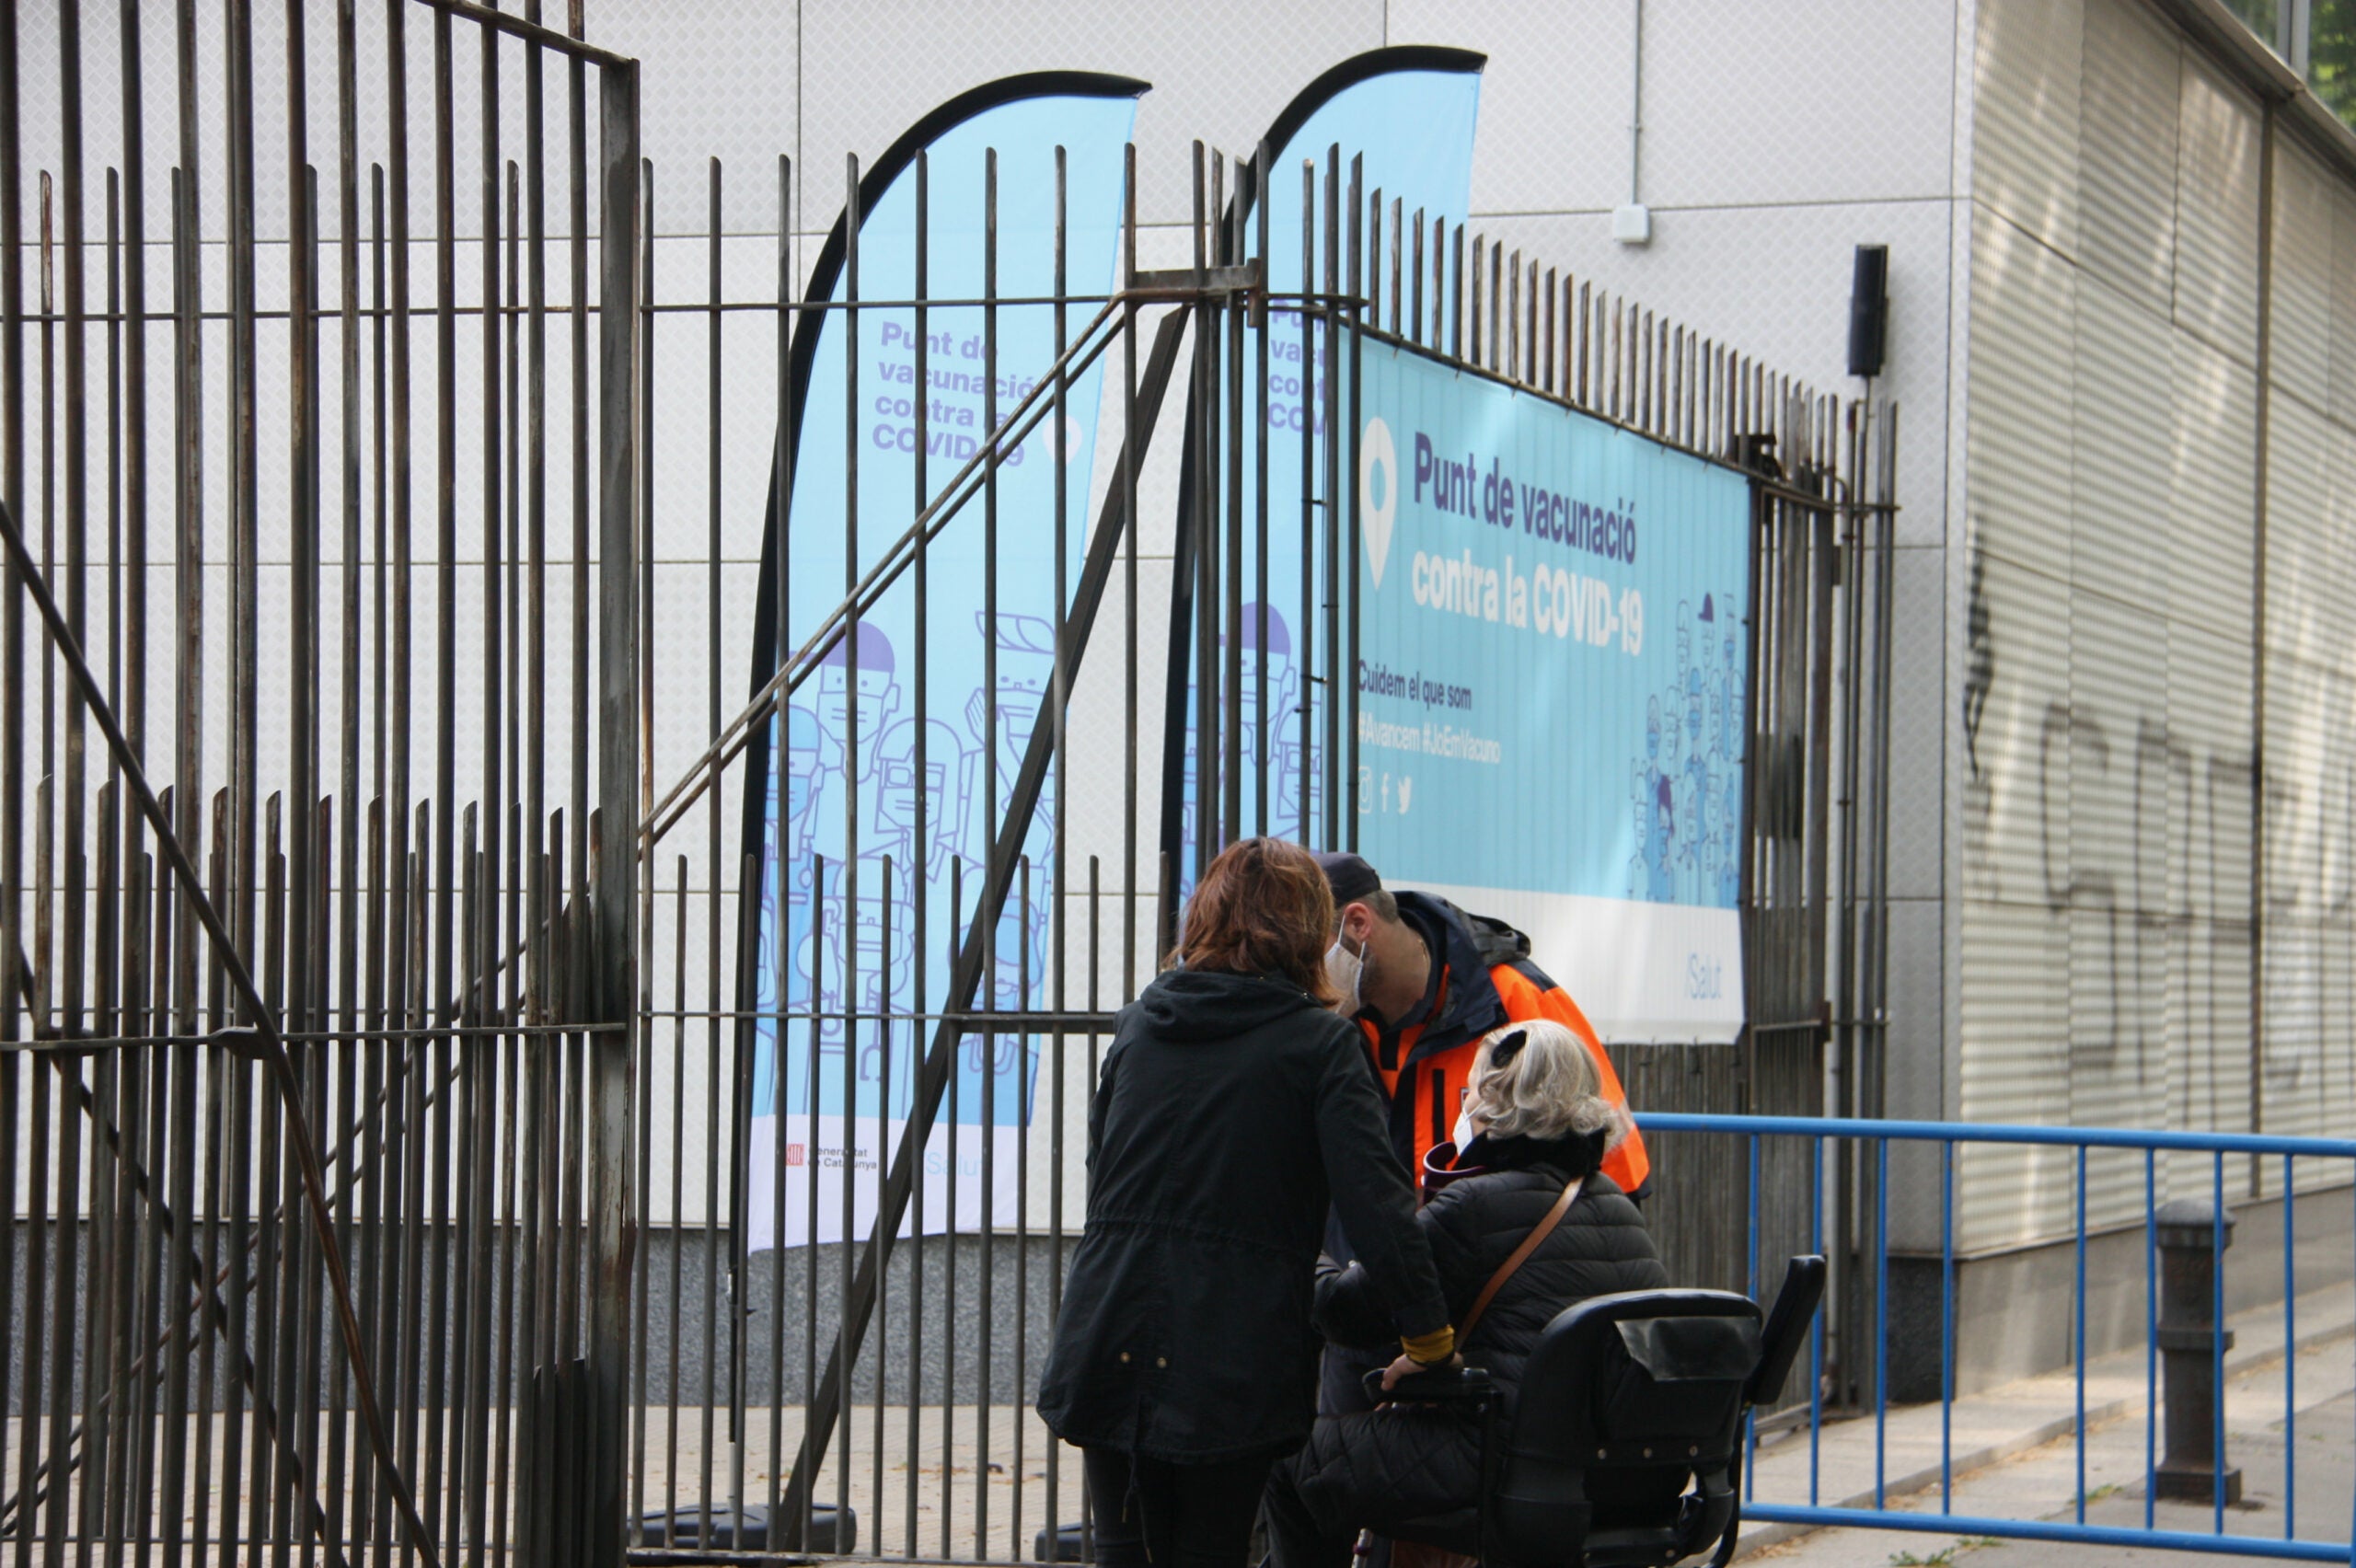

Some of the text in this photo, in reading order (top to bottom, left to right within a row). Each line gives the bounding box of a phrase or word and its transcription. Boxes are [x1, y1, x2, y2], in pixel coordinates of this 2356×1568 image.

[881, 321, 953, 356] Punt
[1415, 431, 1636, 565] Punt de vacunació
[1412, 548, 1643, 657] contra la COVID-19
[1358, 659, 1472, 711] Cuidem el que som
